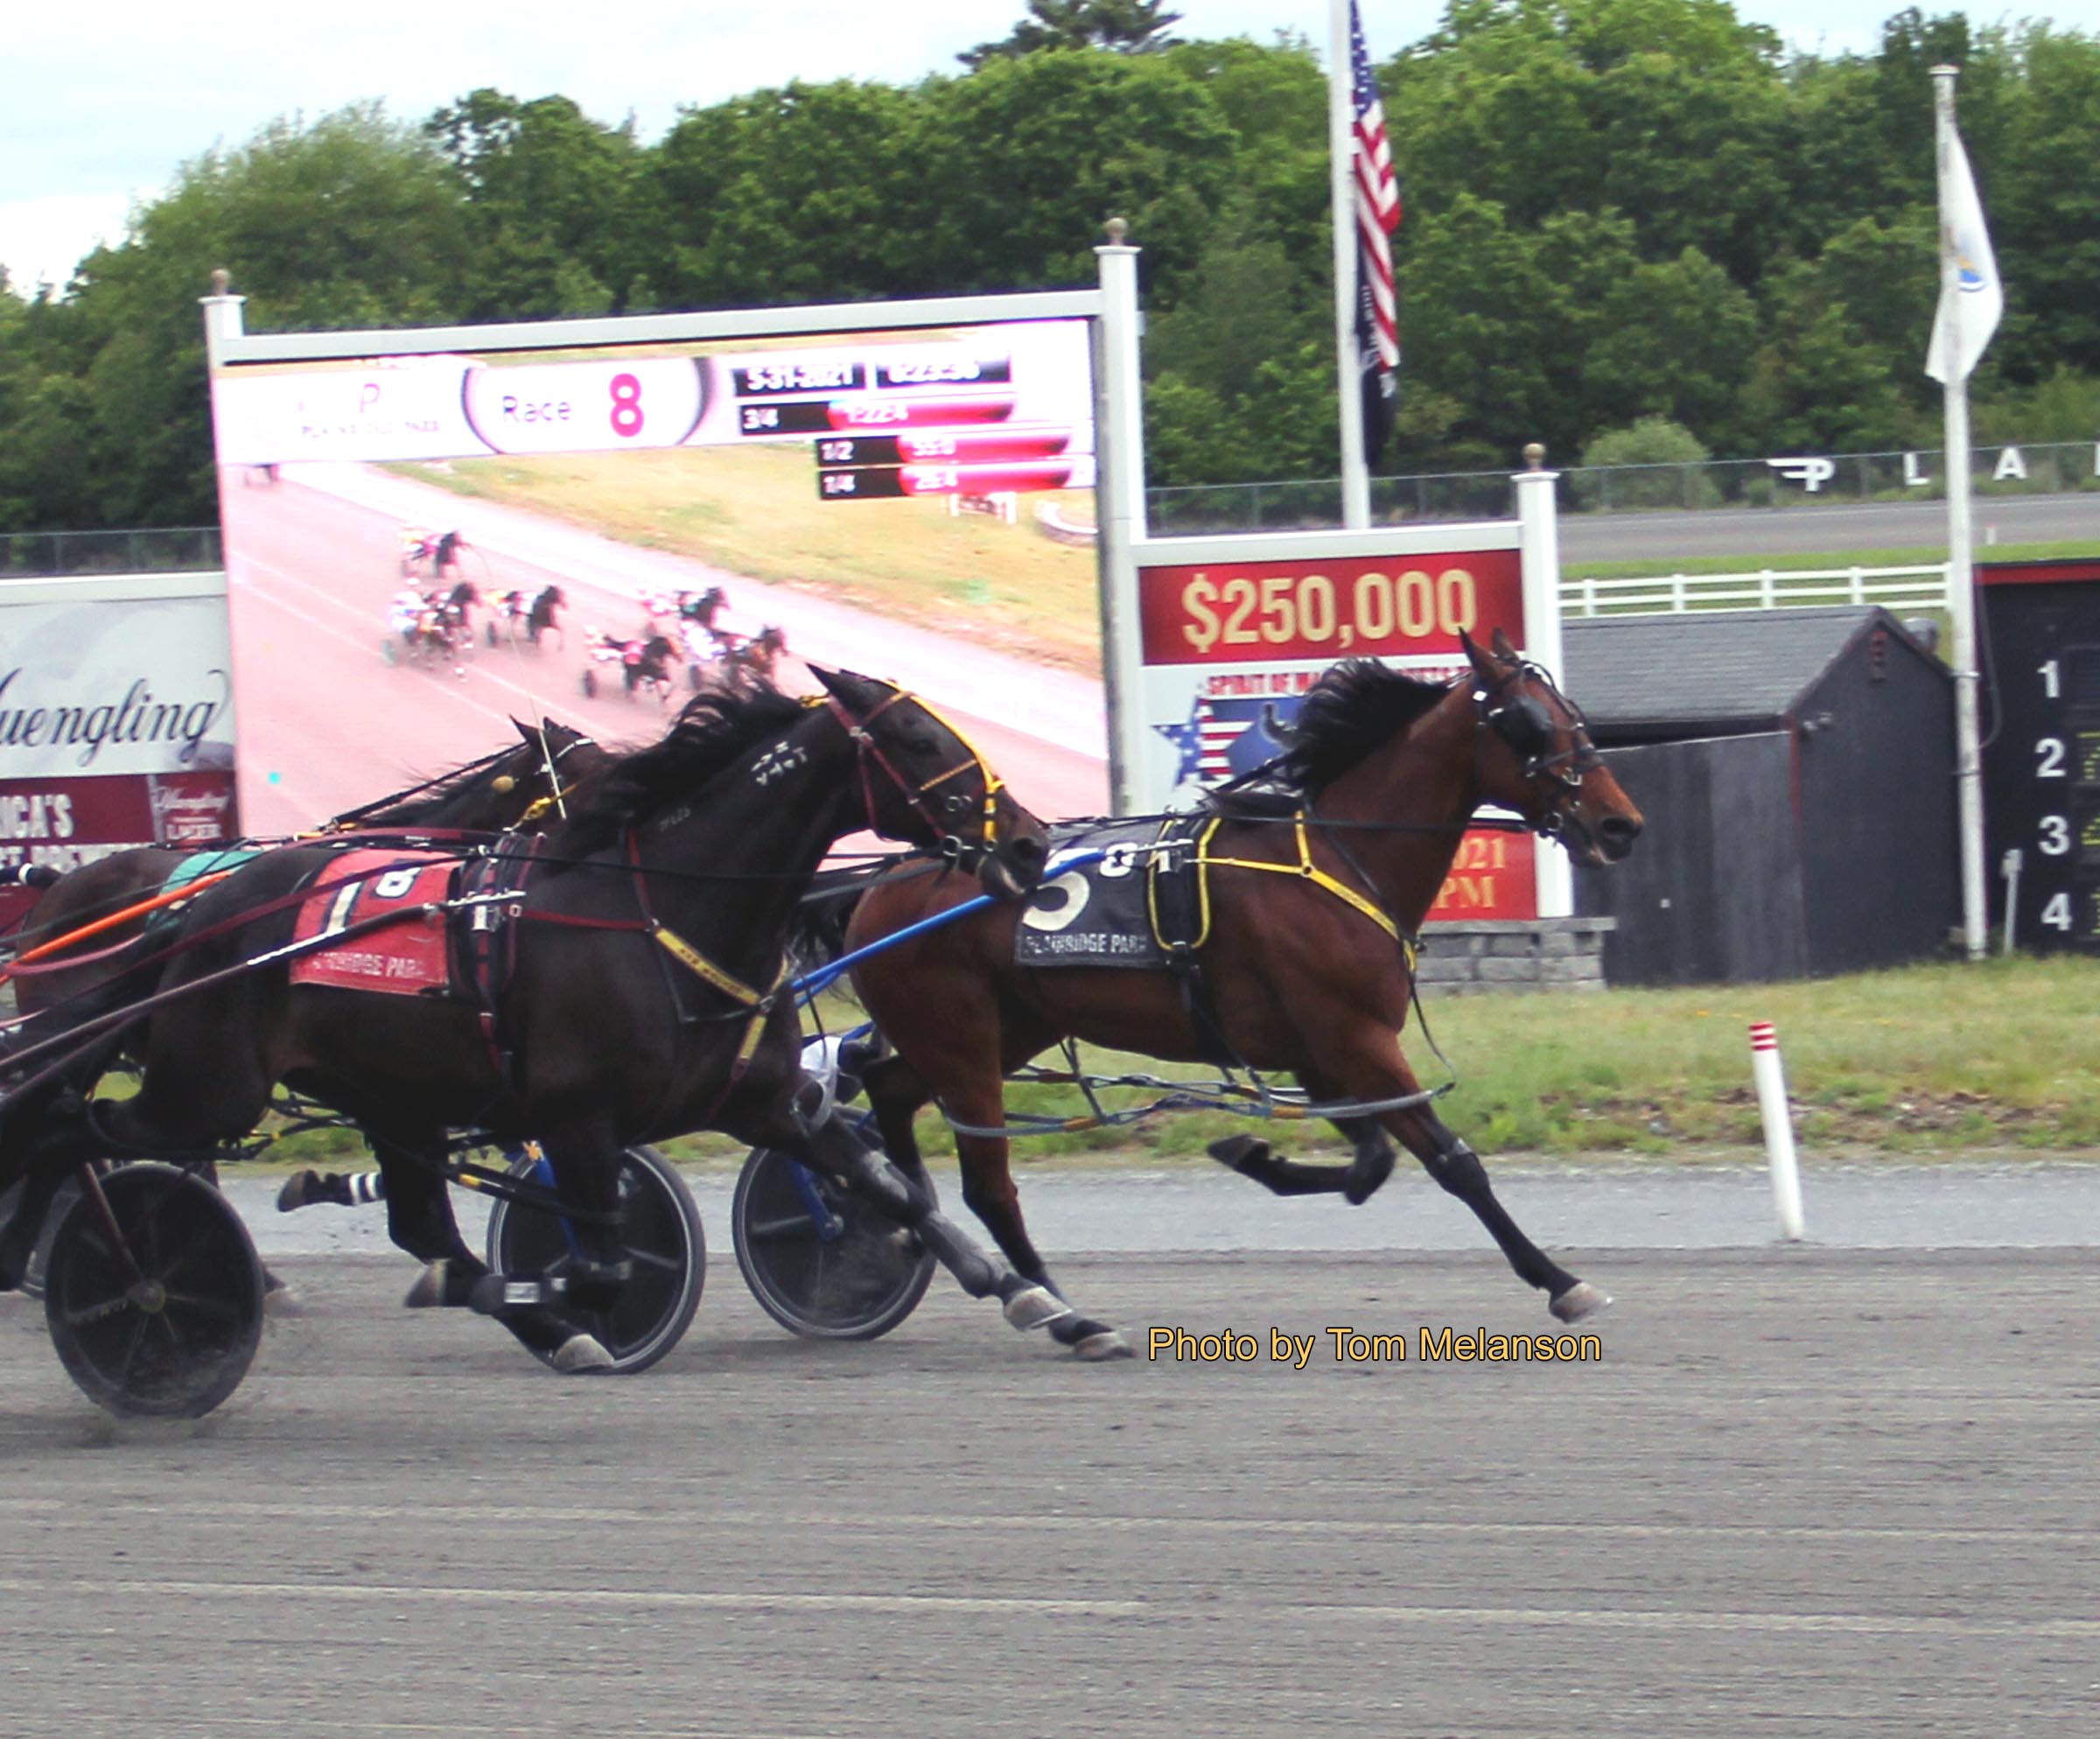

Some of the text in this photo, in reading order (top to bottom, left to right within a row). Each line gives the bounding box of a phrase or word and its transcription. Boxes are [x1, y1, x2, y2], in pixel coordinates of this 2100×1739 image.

[501, 373, 646, 437] Race 8
[820, 441, 855, 462] 1/2
[1180, 568, 1479, 655] $250,000
[2036, 660, 2061, 698] 1
[2034, 738, 2068, 778] 2
[2038, 815, 2070, 855] 3
[1098, 842, 1138, 877] 8
[1022, 847, 1090, 931] 5
[1435, 875, 1495, 908] PM
[2040, 893, 2072, 931] 4
